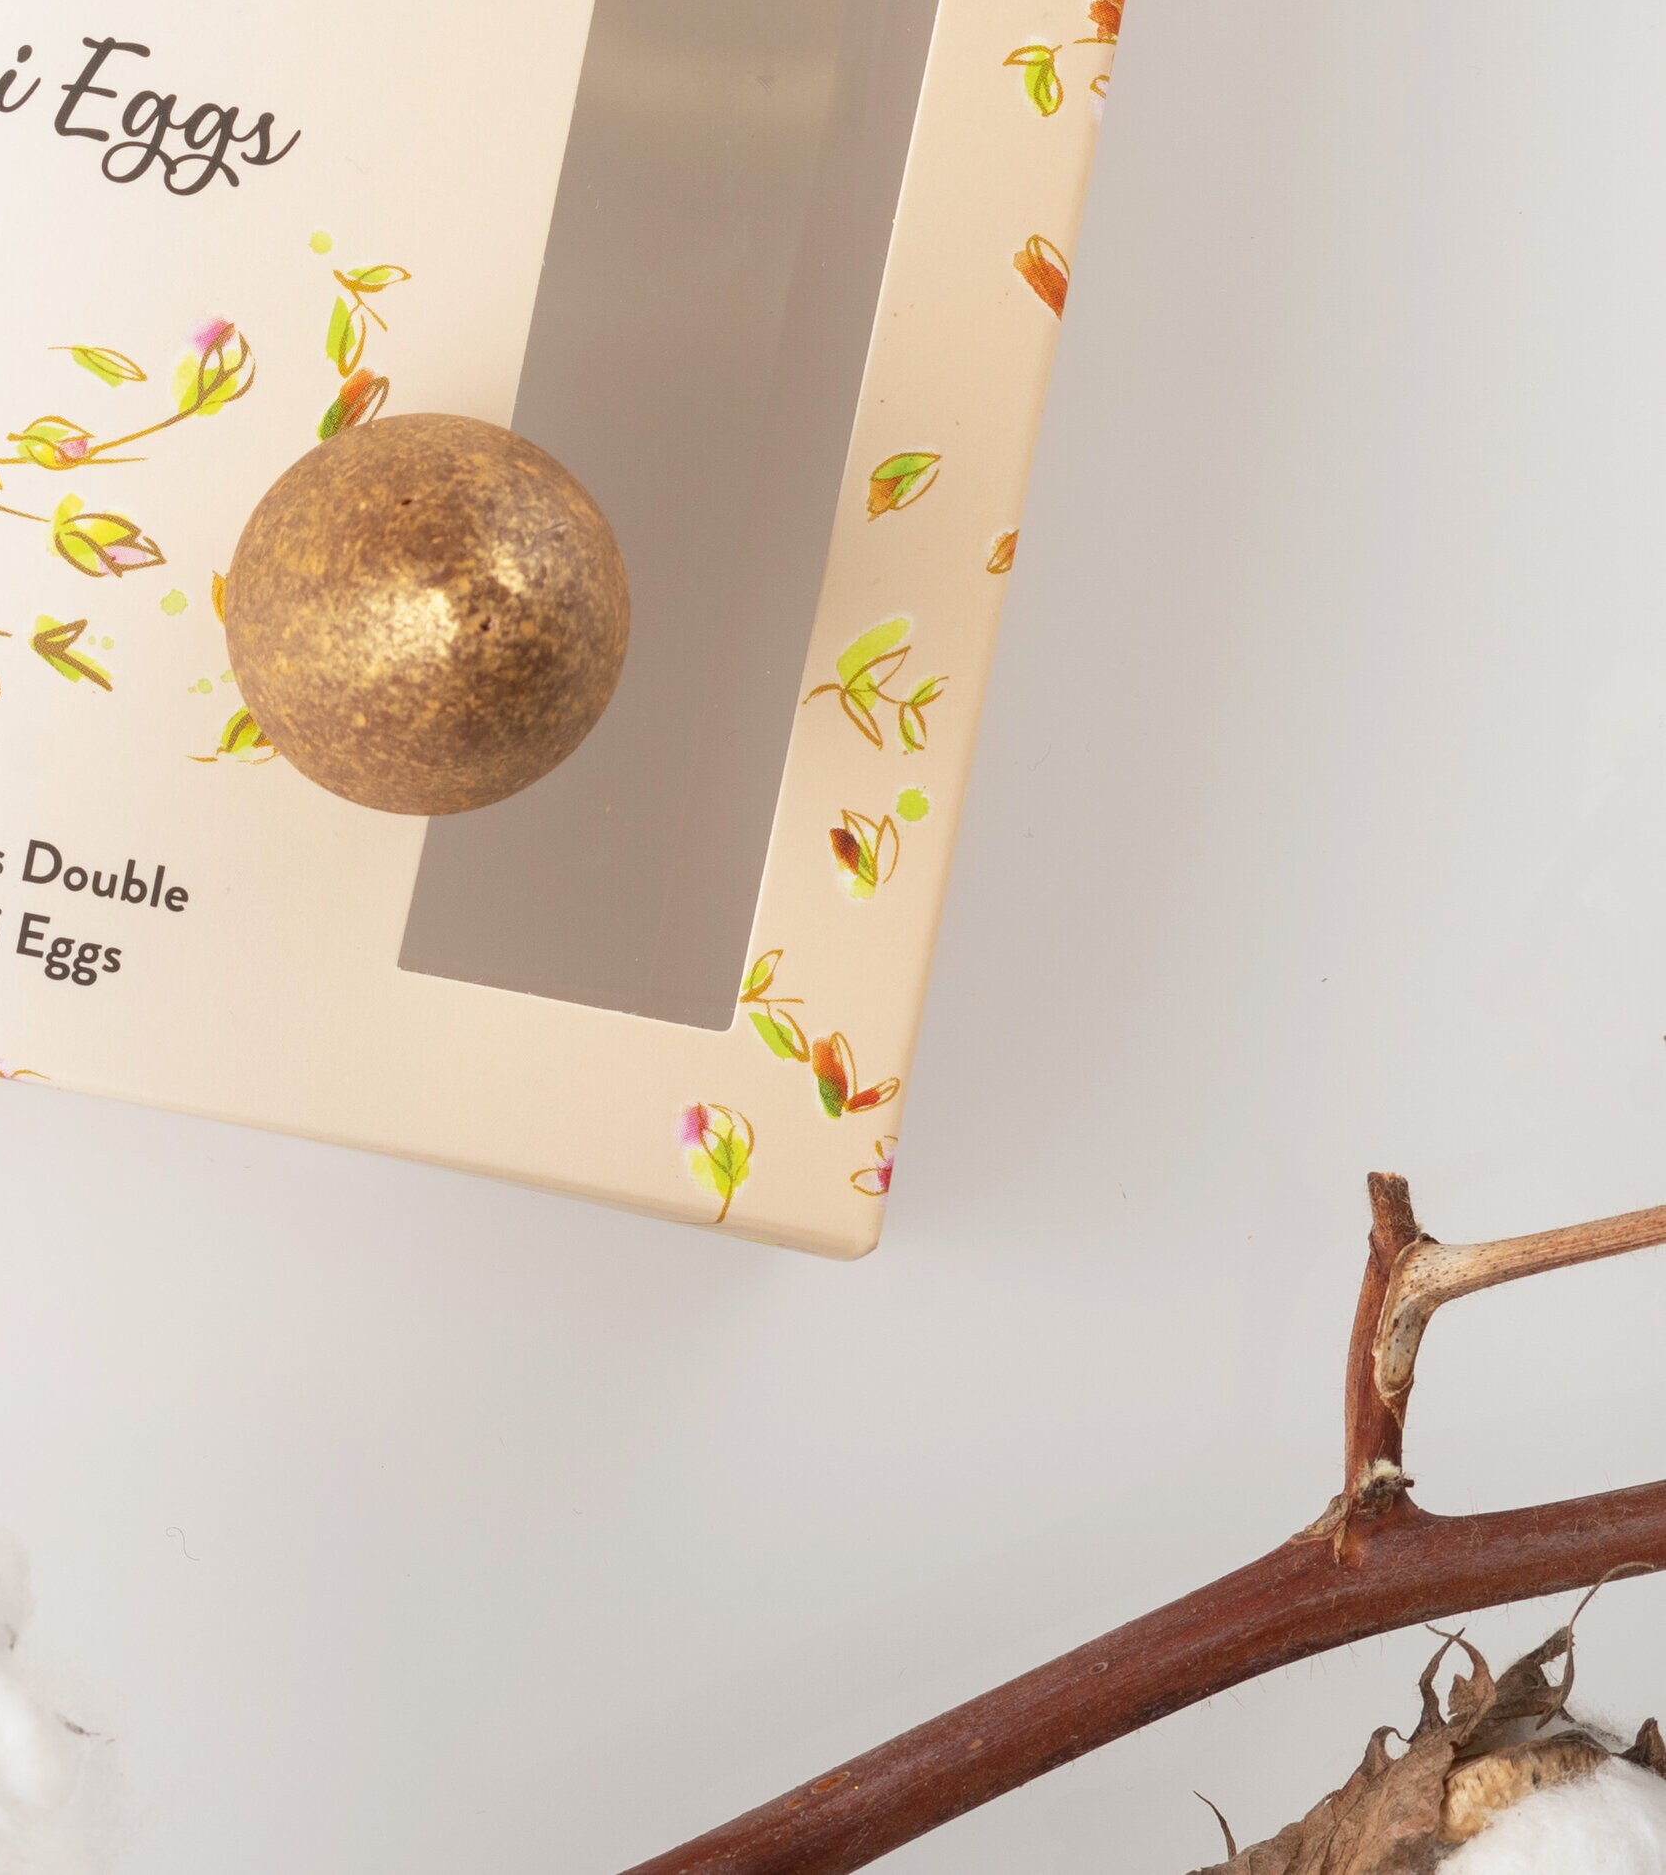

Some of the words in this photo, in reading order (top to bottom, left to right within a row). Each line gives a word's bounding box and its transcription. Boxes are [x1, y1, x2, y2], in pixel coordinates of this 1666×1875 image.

[55, 37, 300, 195] Eggs
[22, 840, 188, 912] Double
[17, 913, 121, 986] Eggs
